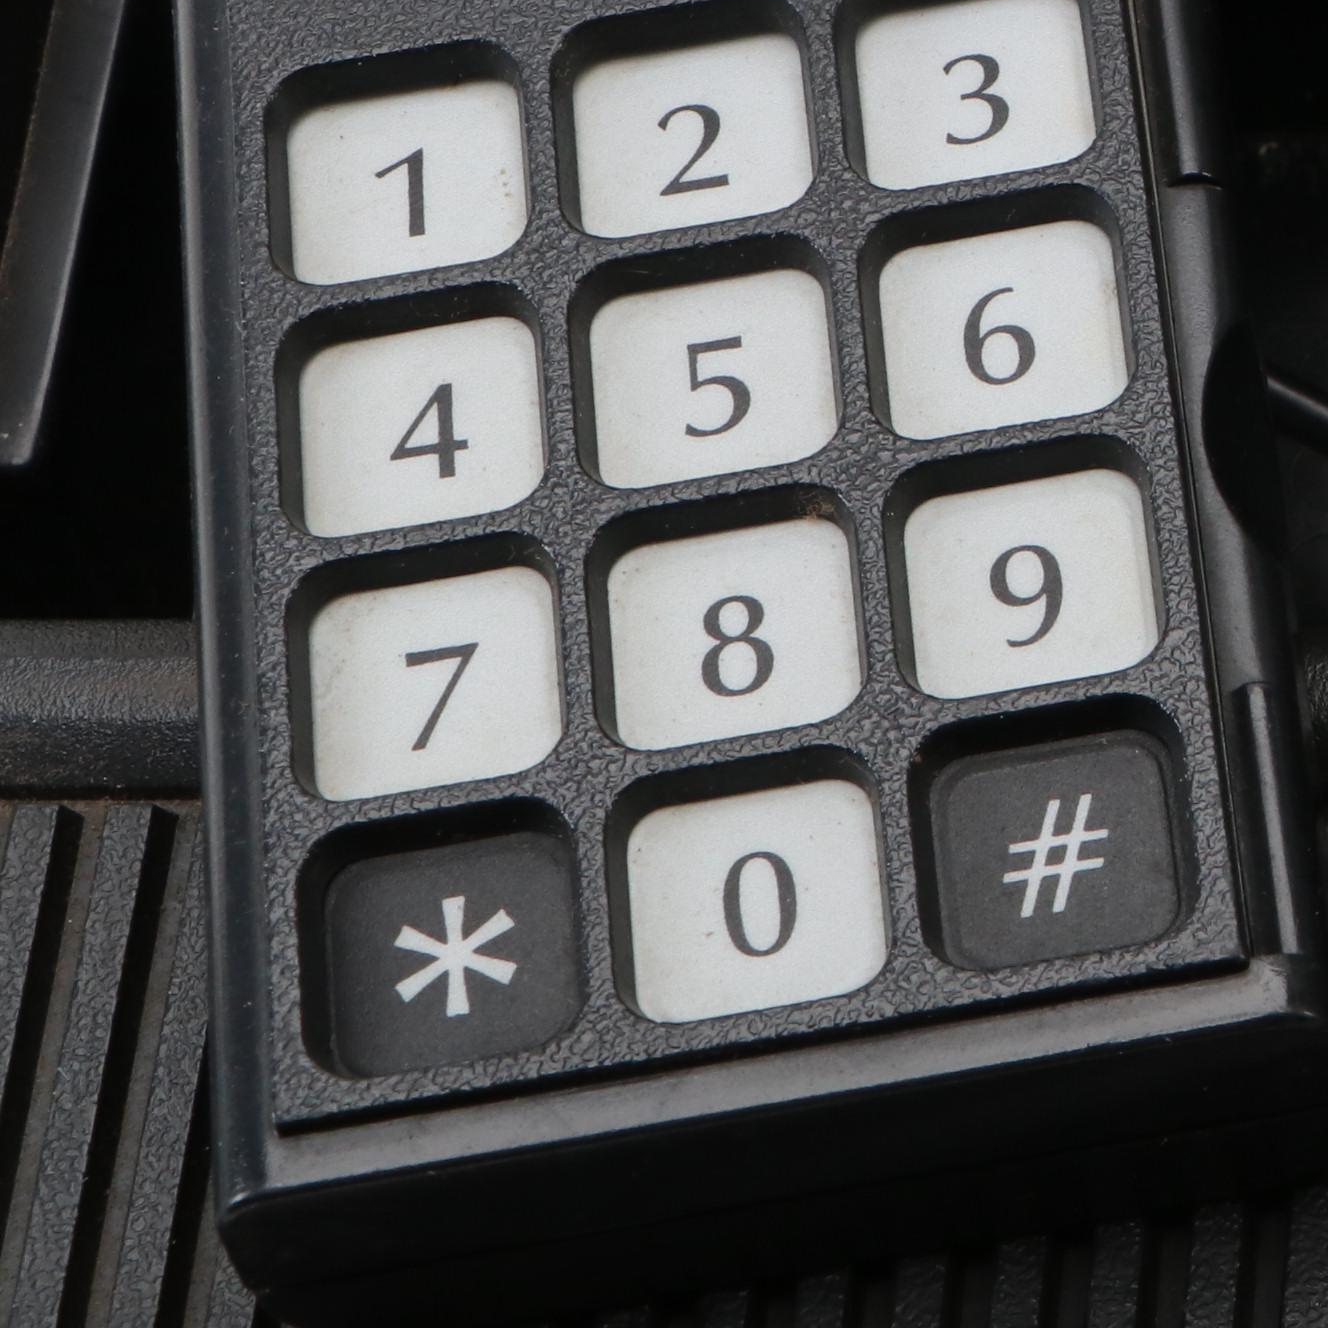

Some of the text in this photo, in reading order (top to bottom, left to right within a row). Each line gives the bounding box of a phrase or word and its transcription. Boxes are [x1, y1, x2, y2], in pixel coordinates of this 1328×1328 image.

[375, 54, 1009, 236] 1 2 3
[390, 288, 1035, 478] 4 5 6
[405, 545, 1062, 750] 7 8 9
[723, 852, 797, 957] 0
